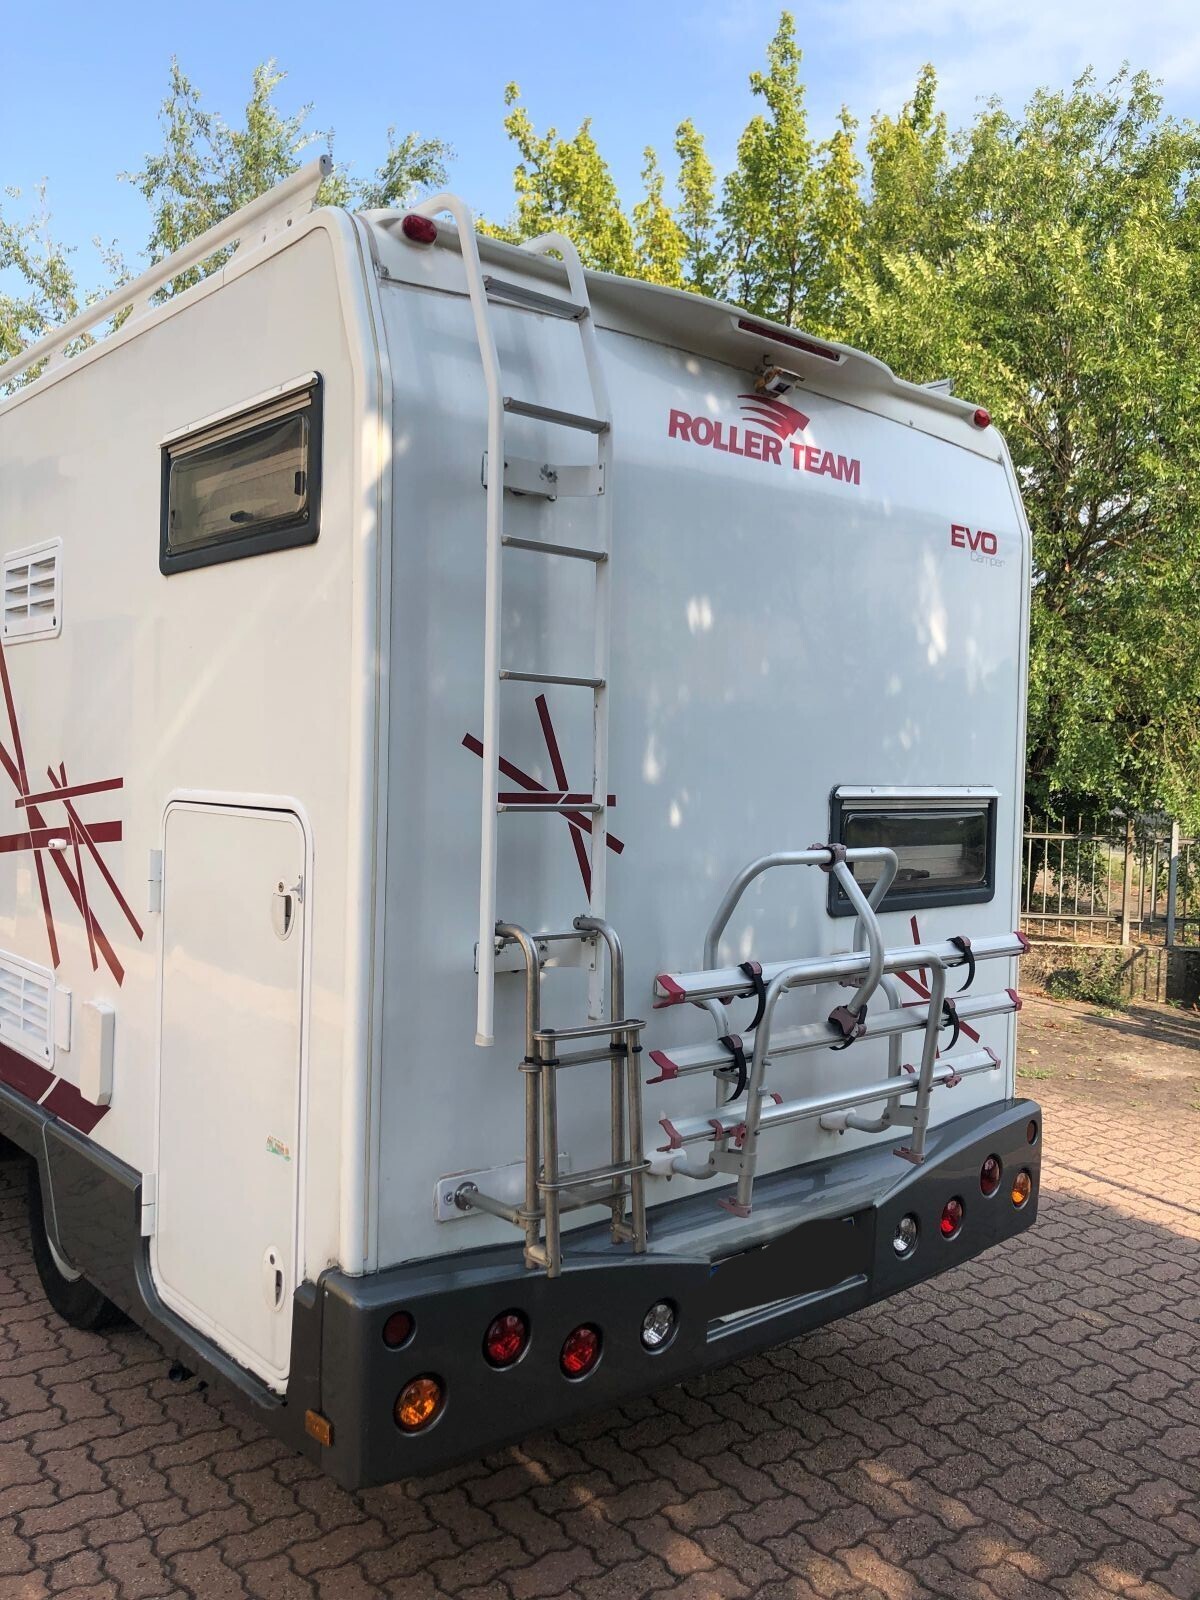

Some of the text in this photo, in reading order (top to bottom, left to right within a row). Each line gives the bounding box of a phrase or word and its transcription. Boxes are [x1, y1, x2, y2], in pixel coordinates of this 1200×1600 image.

[668, 409, 861, 486] ROLLER TEAM
[951, 524, 998, 556] EVO
[970, 550, 1006, 569] Camper
